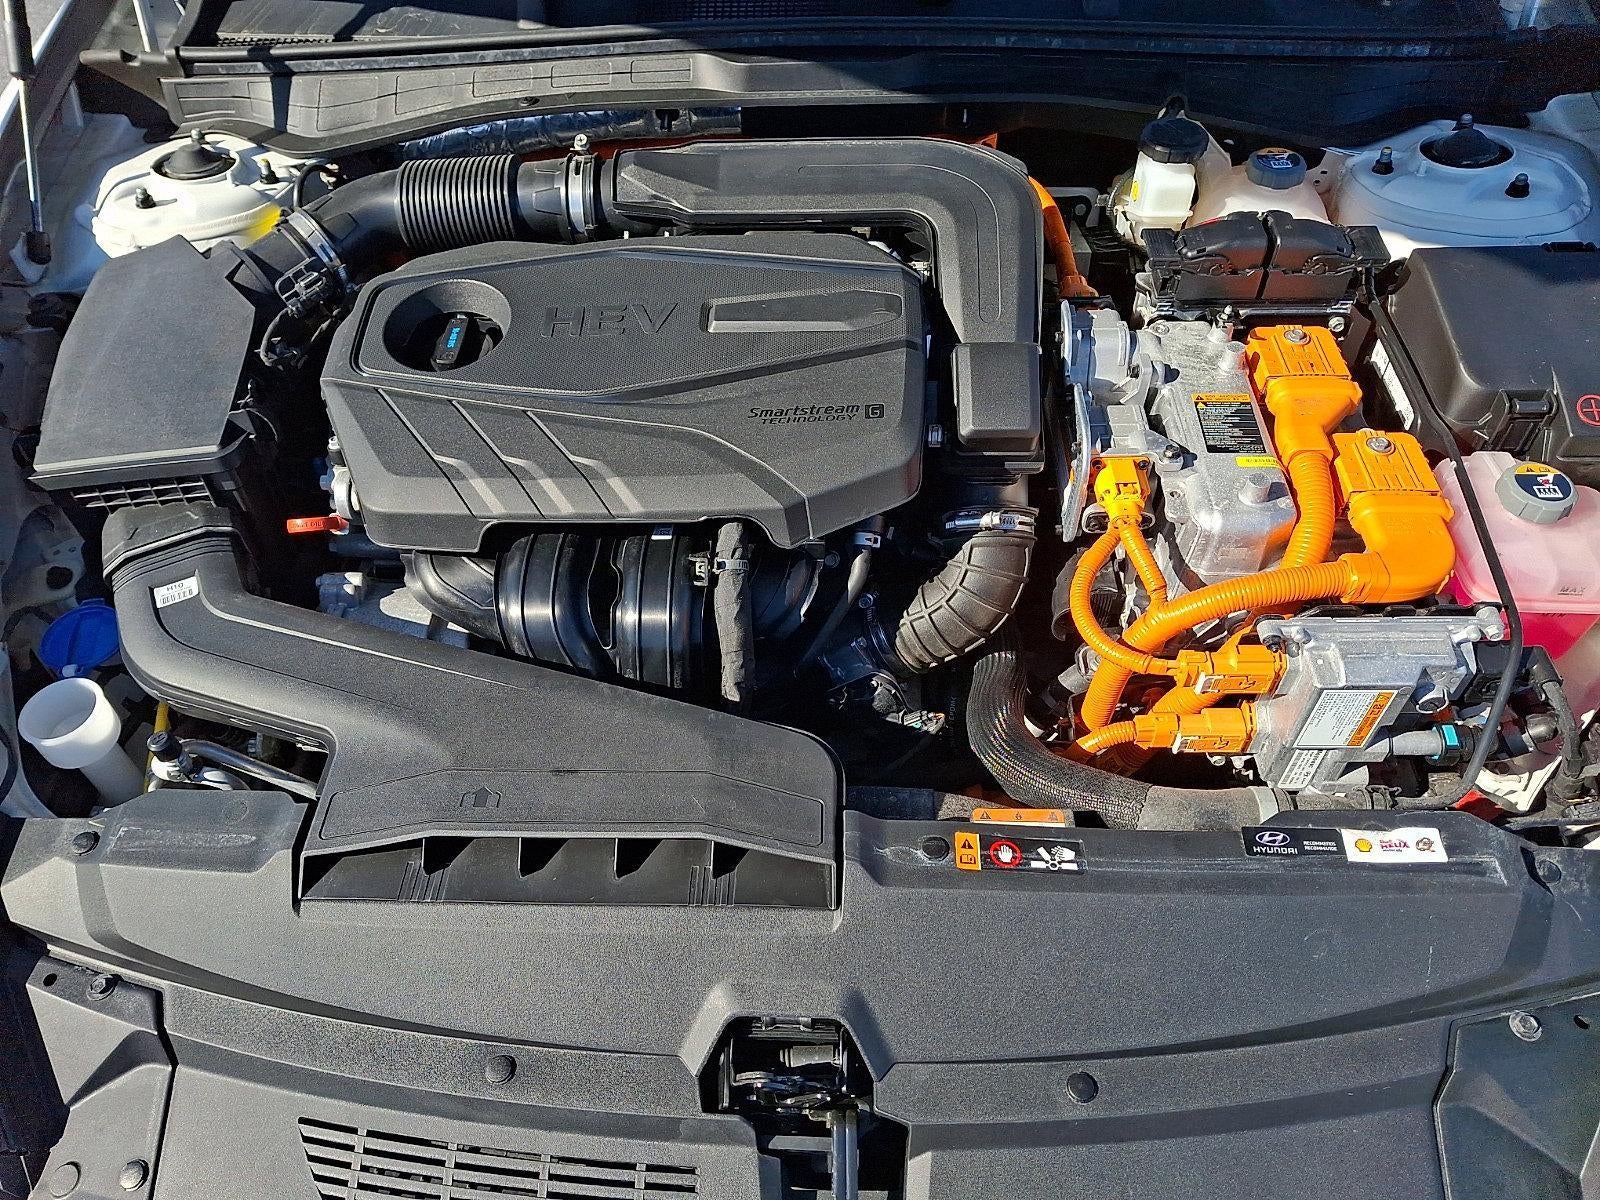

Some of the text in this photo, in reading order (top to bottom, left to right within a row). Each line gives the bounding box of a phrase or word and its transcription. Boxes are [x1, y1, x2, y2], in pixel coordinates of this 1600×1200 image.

[541, 303, 678, 337] HEV
[748, 404, 882, 418] Smartstream G
[762, 413, 857, 424] TECHNOLOGY
[1253, 845, 1299, 855] HYUNDAI
[1380, 840, 1411, 849] HELIX
